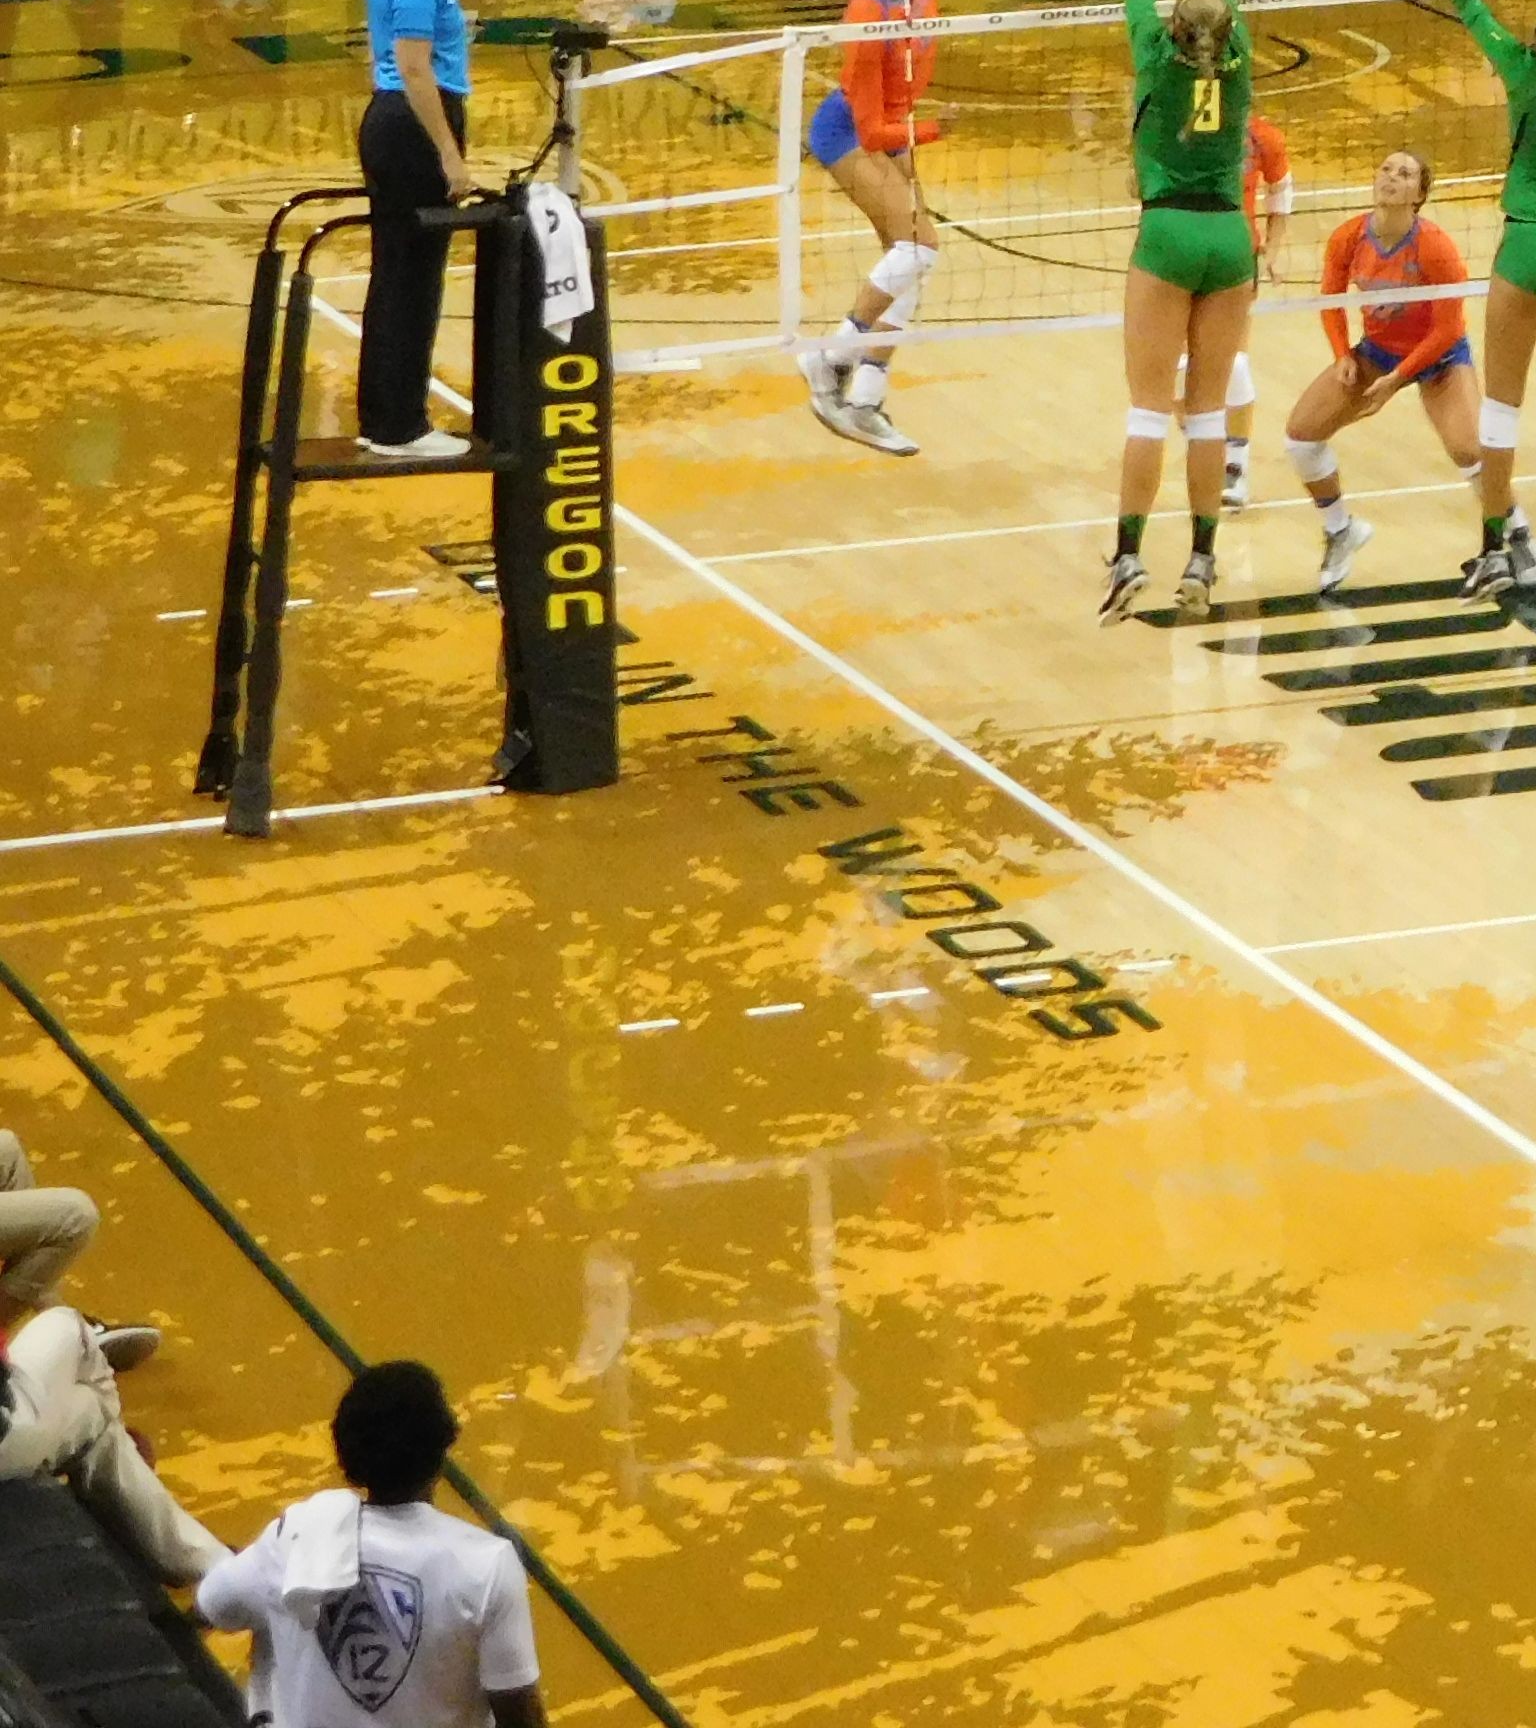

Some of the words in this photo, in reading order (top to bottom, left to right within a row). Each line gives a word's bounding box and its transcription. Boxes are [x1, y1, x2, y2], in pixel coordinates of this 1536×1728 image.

[1040, 5, 1127, 22] OREGON
[540, 353, 605, 630] OREGON
[665, 714, 864, 816] THE
[816, 826, 1164, 1042] WOODS
[350, 1643, 390, 1683] 12
